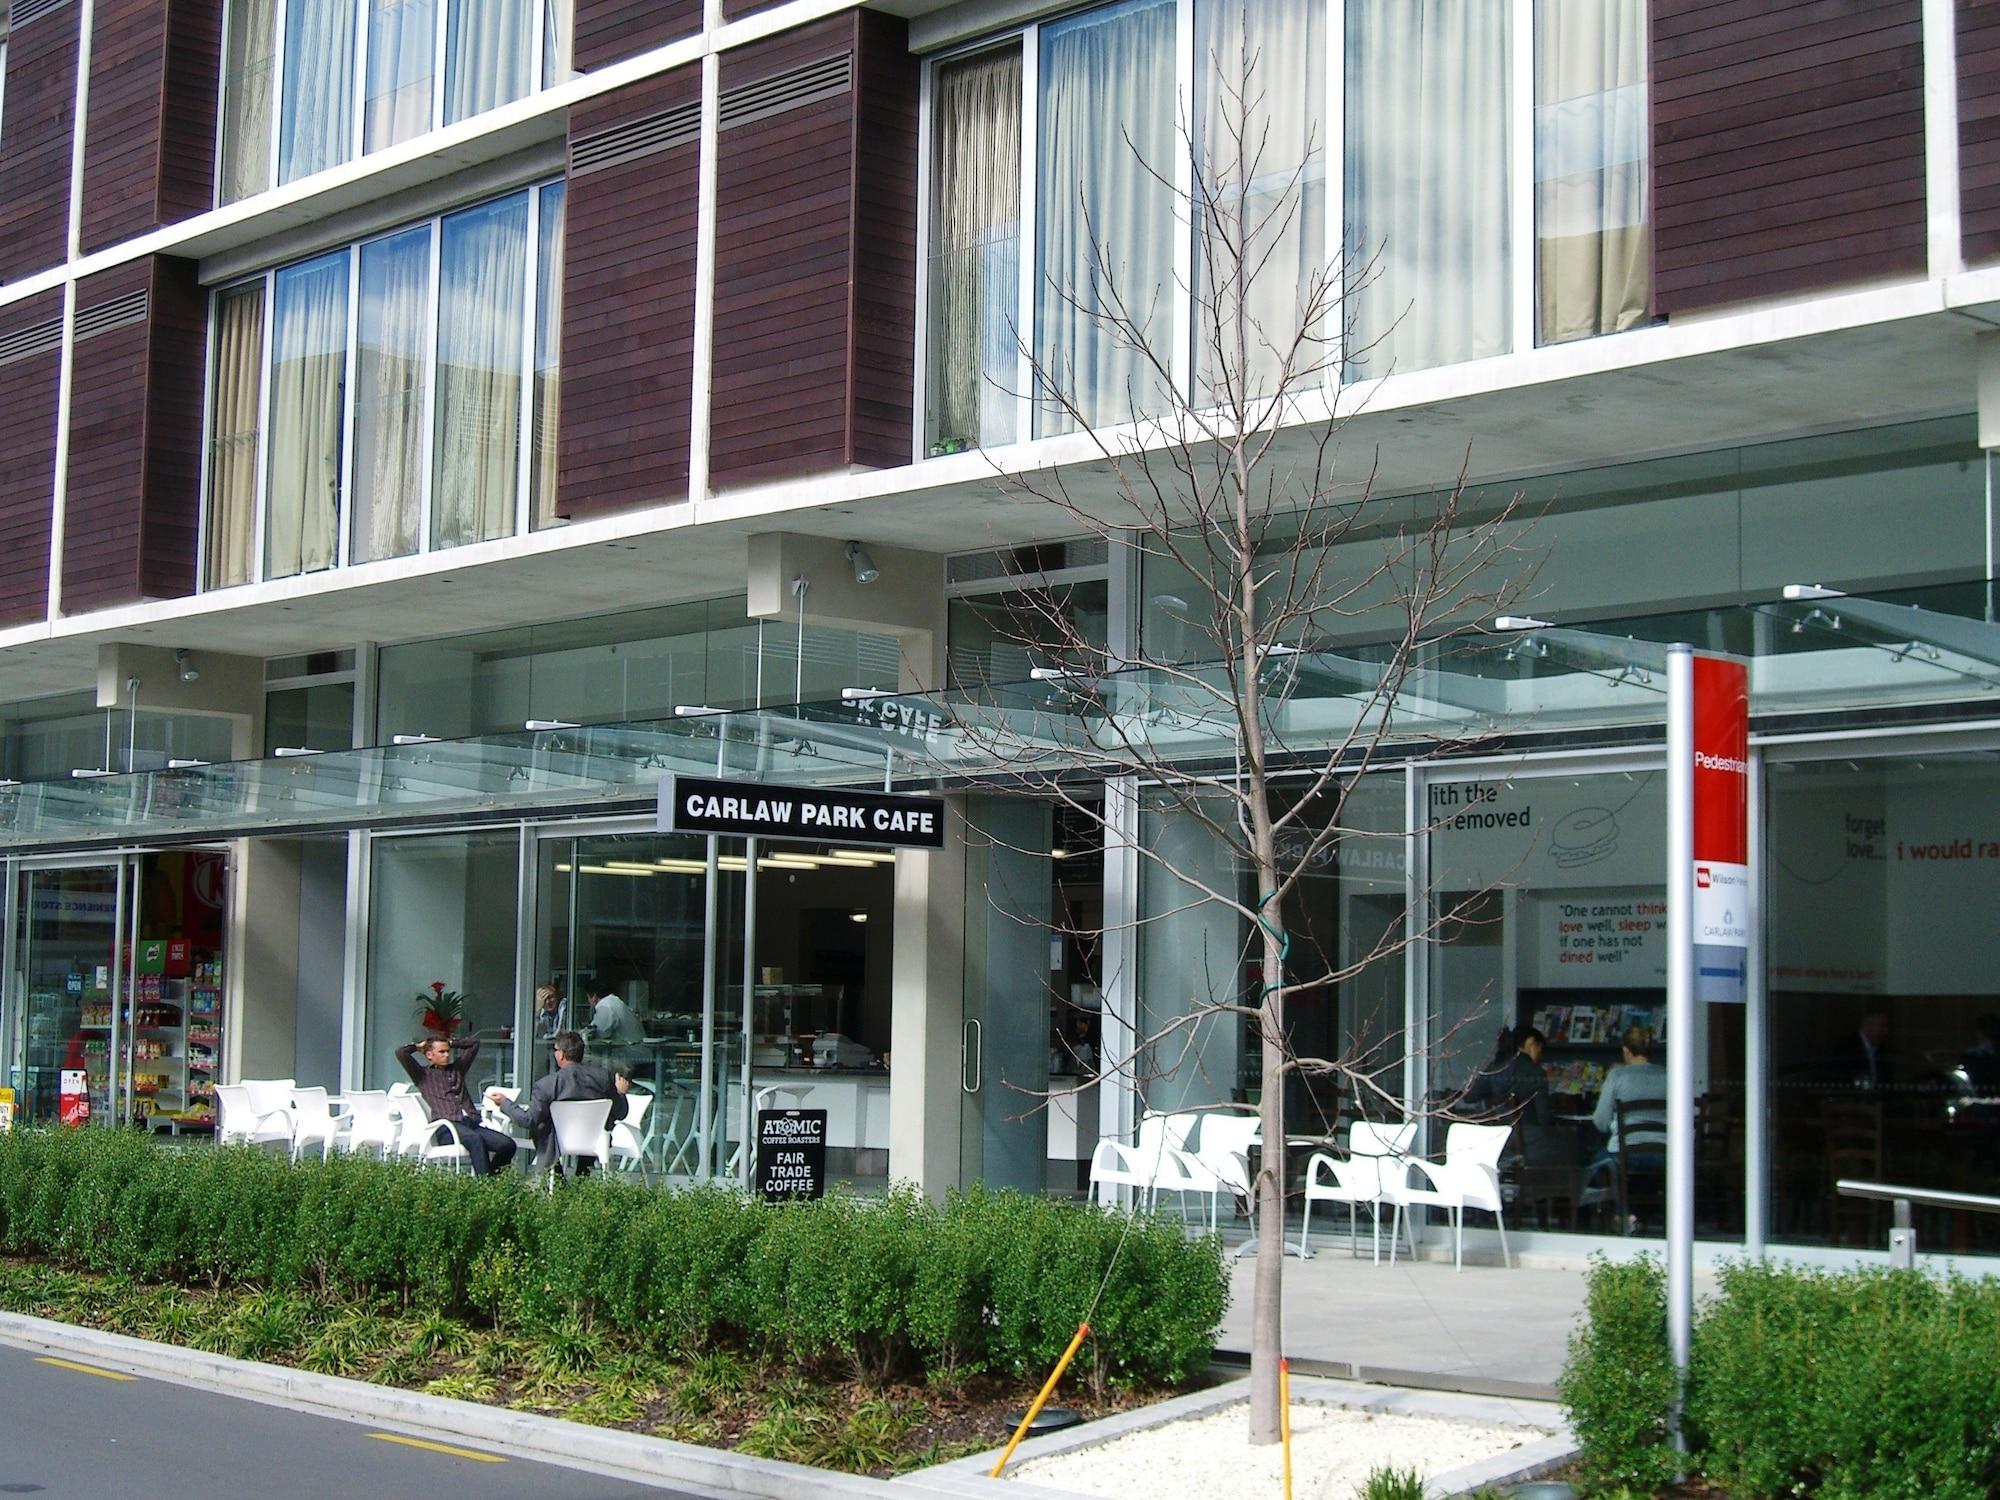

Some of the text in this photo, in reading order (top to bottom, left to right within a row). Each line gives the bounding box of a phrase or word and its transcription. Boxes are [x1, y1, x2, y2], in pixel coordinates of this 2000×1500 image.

[1465, 784, 1498, 803] the
[686, 795, 934, 833] CARLAW PARK CAFE
[1446, 806, 1531, 830] removed
[1897, 842, 1904, 860] i
[1910, 838, 1973, 860] would
[1591, 904, 1632, 916] cannot
[1559, 921, 1584, 933] love
[1618, 919, 1651, 932] sleep
[1572, 937, 1595, 949] one
[1598, 936, 1619, 948] has
[1622, 936, 1643, 947] not
[1560, 951, 1593, 963] dined
[763, 1117, 822, 1136] ATOMIC
[762, 1136, 820, 1145] COFFEE ROASTERS
[777, 1152, 804, 1164] FAIR
[770, 1165, 811, 1178] TRADE
[766, 1179, 814, 1192] COFFEE
